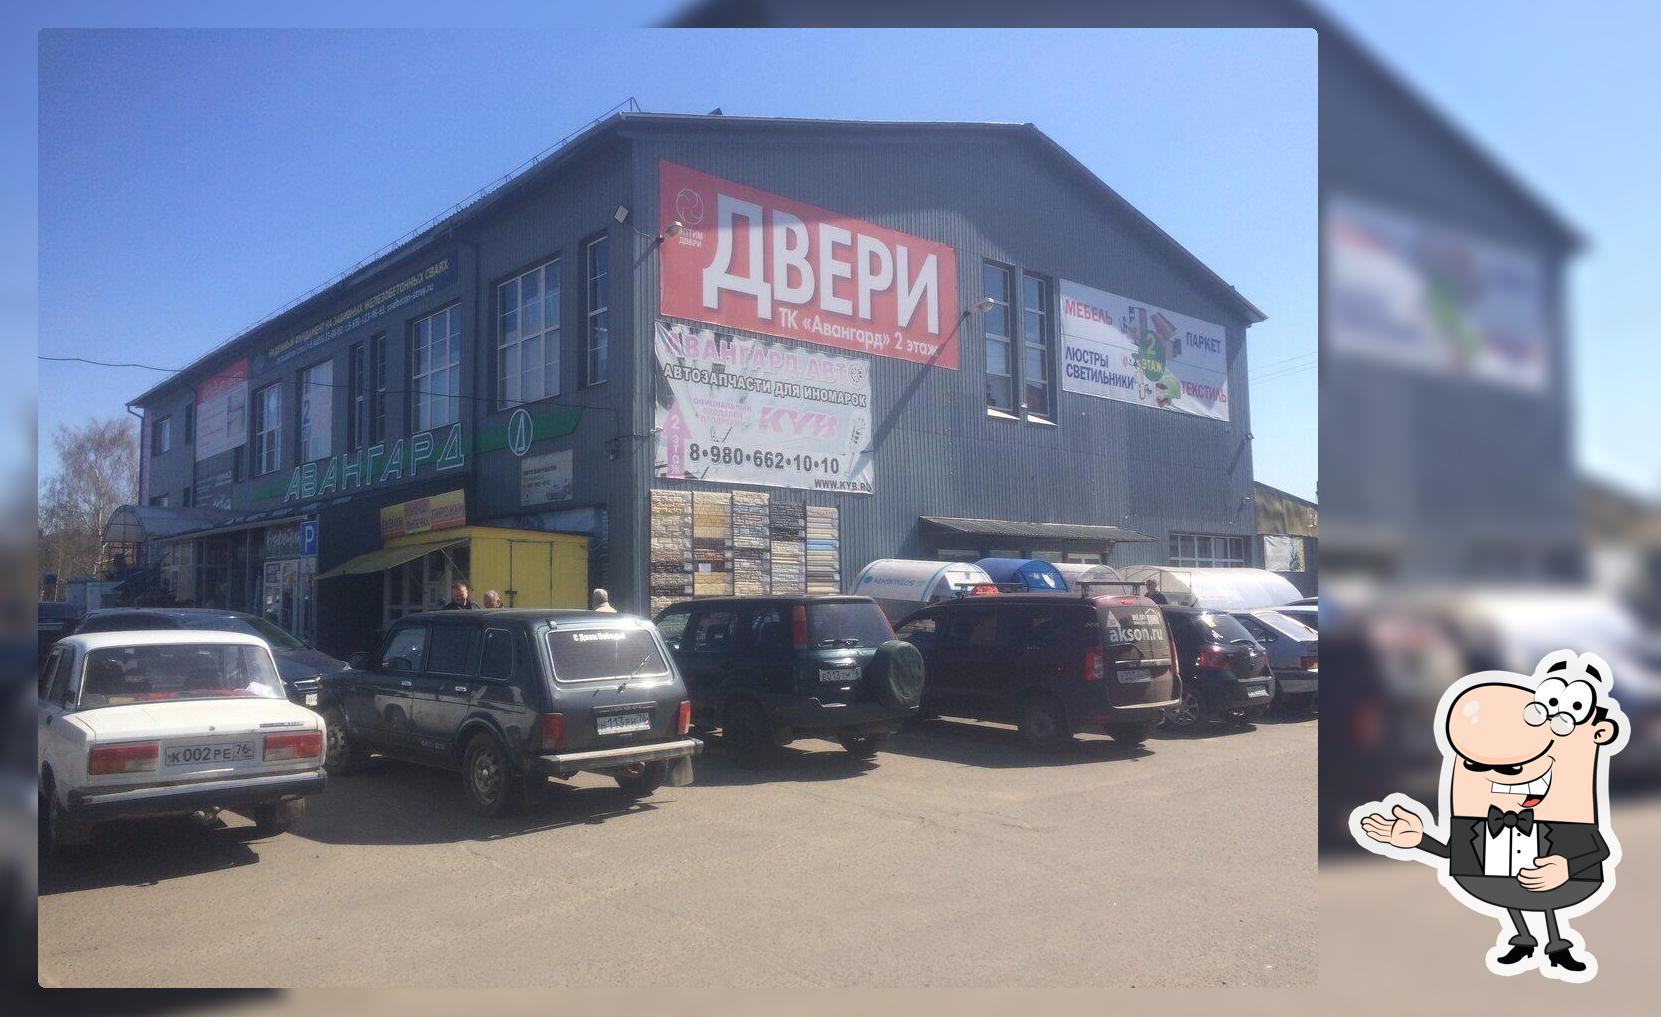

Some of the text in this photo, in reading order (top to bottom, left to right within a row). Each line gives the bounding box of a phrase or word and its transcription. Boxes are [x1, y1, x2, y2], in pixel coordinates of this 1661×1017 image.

[425, 258, 449, 280] СВАЯХ
[702, 192, 939, 336] ДВЕРИ
[1064, 299, 1113, 326] МЕБЕЛЬ
[778, 308, 940, 357] ТК «Авангард» 2 этаж
[1145, 333, 1157, 355] 2
[1185, 331, 1221, 353] ПАРКЕТ
[1065, 345, 1109, 368] ЛЮСТРЫ
[1141, 360, 1163, 372] ЭТАЖ
[663, 363, 867, 408] АВТОЗАПЧАСТИ ДЛЯ ИНОМАРОК
[1066, 363, 1136, 390] СВЕТИЛЬНИКИ
[1181, 380, 1227, 403] ТЕКСТИЛЬ
[670, 414, 680, 430] 2
[758, 406, 839, 440] KYB
[284, 422, 465, 502] АВАНГАРД
[304, 525, 315, 553] P
[1109, 628, 1163, 642] akson.ru
